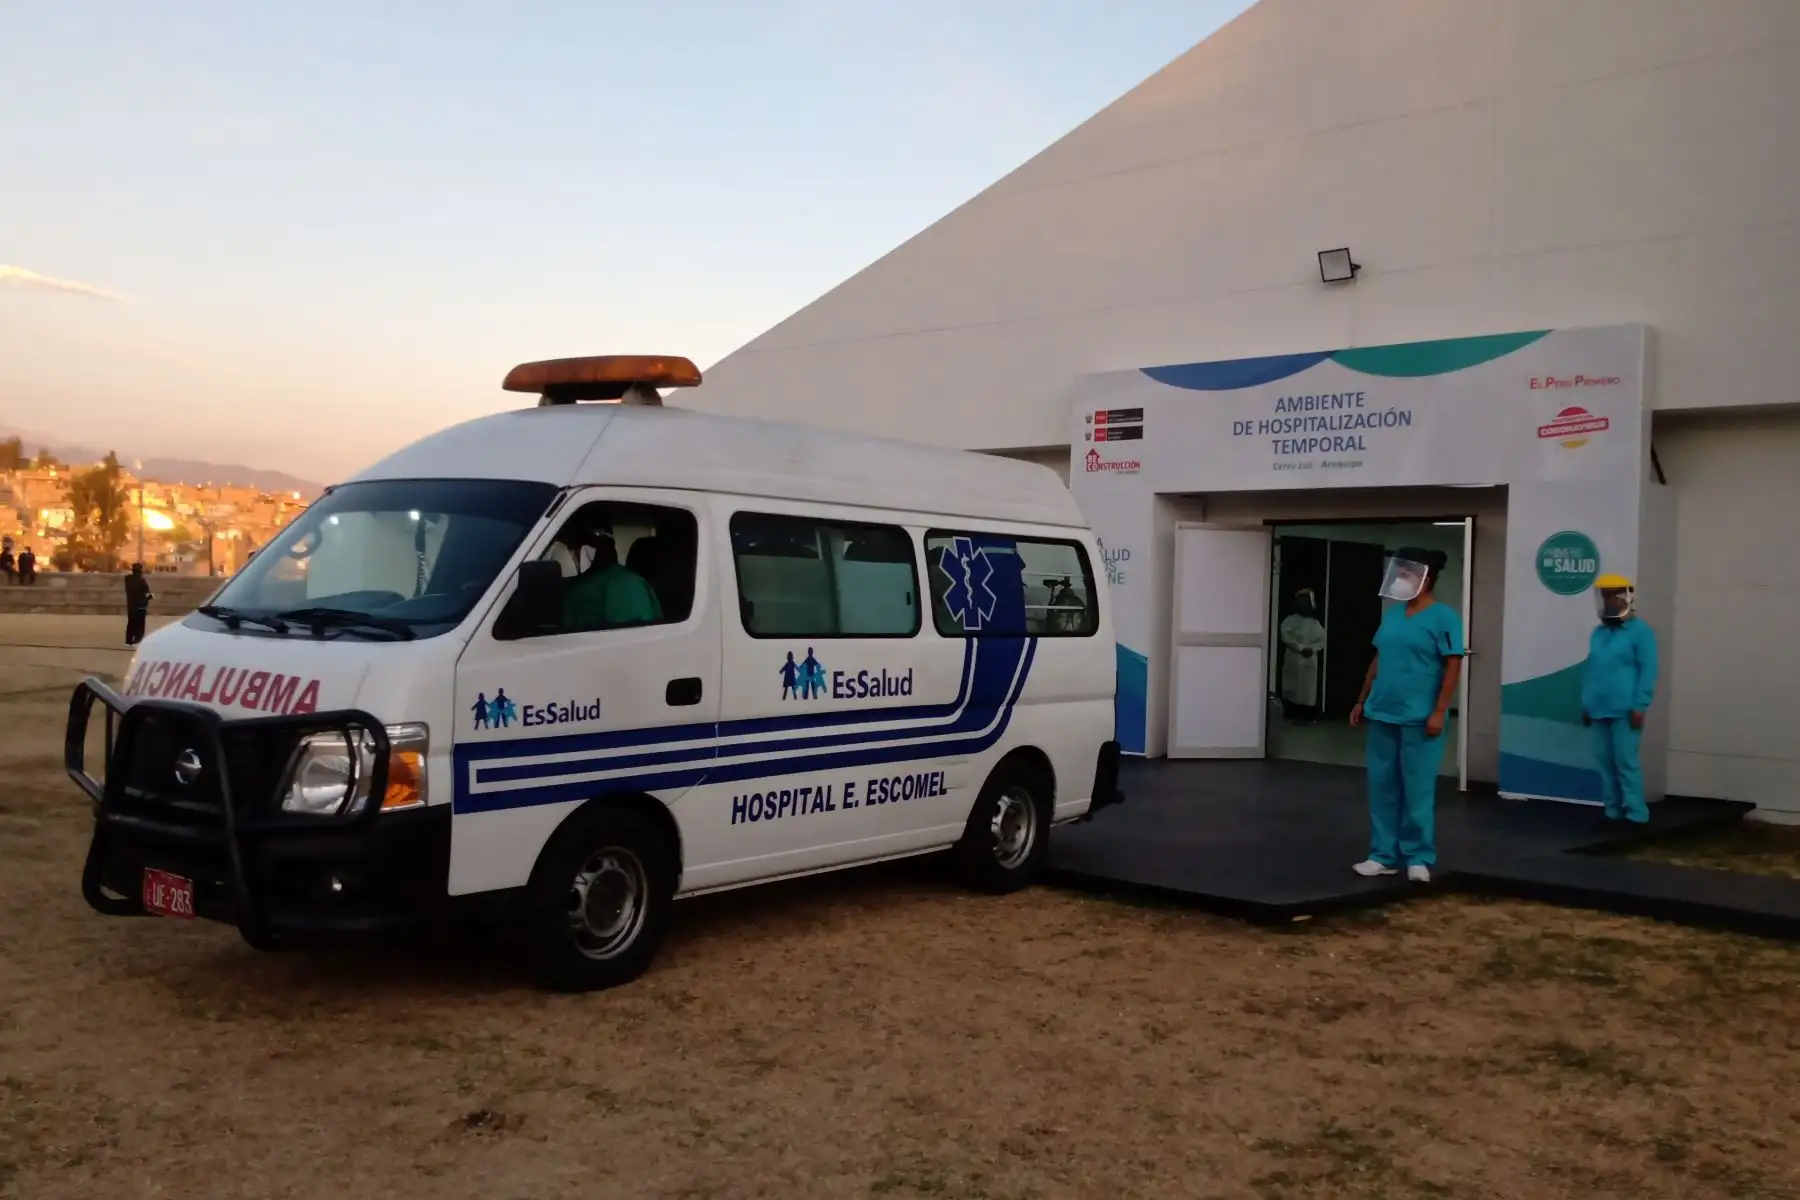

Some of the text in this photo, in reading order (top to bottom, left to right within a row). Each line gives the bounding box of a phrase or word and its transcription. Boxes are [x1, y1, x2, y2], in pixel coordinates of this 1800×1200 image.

[1275, 391, 1365, 413] AMBIENTE
[1233, 407, 1412, 436] DE HOSPITALIZACIÓN
[1272, 435, 1366, 454] TEMPORAL
[1554, 558, 1596, 573] SALUD
[833, 667, 913, 699] EsSalud
[523, 697, 600, 726] EsSalud
[731, 771, 948, 825] HOSPITAL E. ESCOMEL
